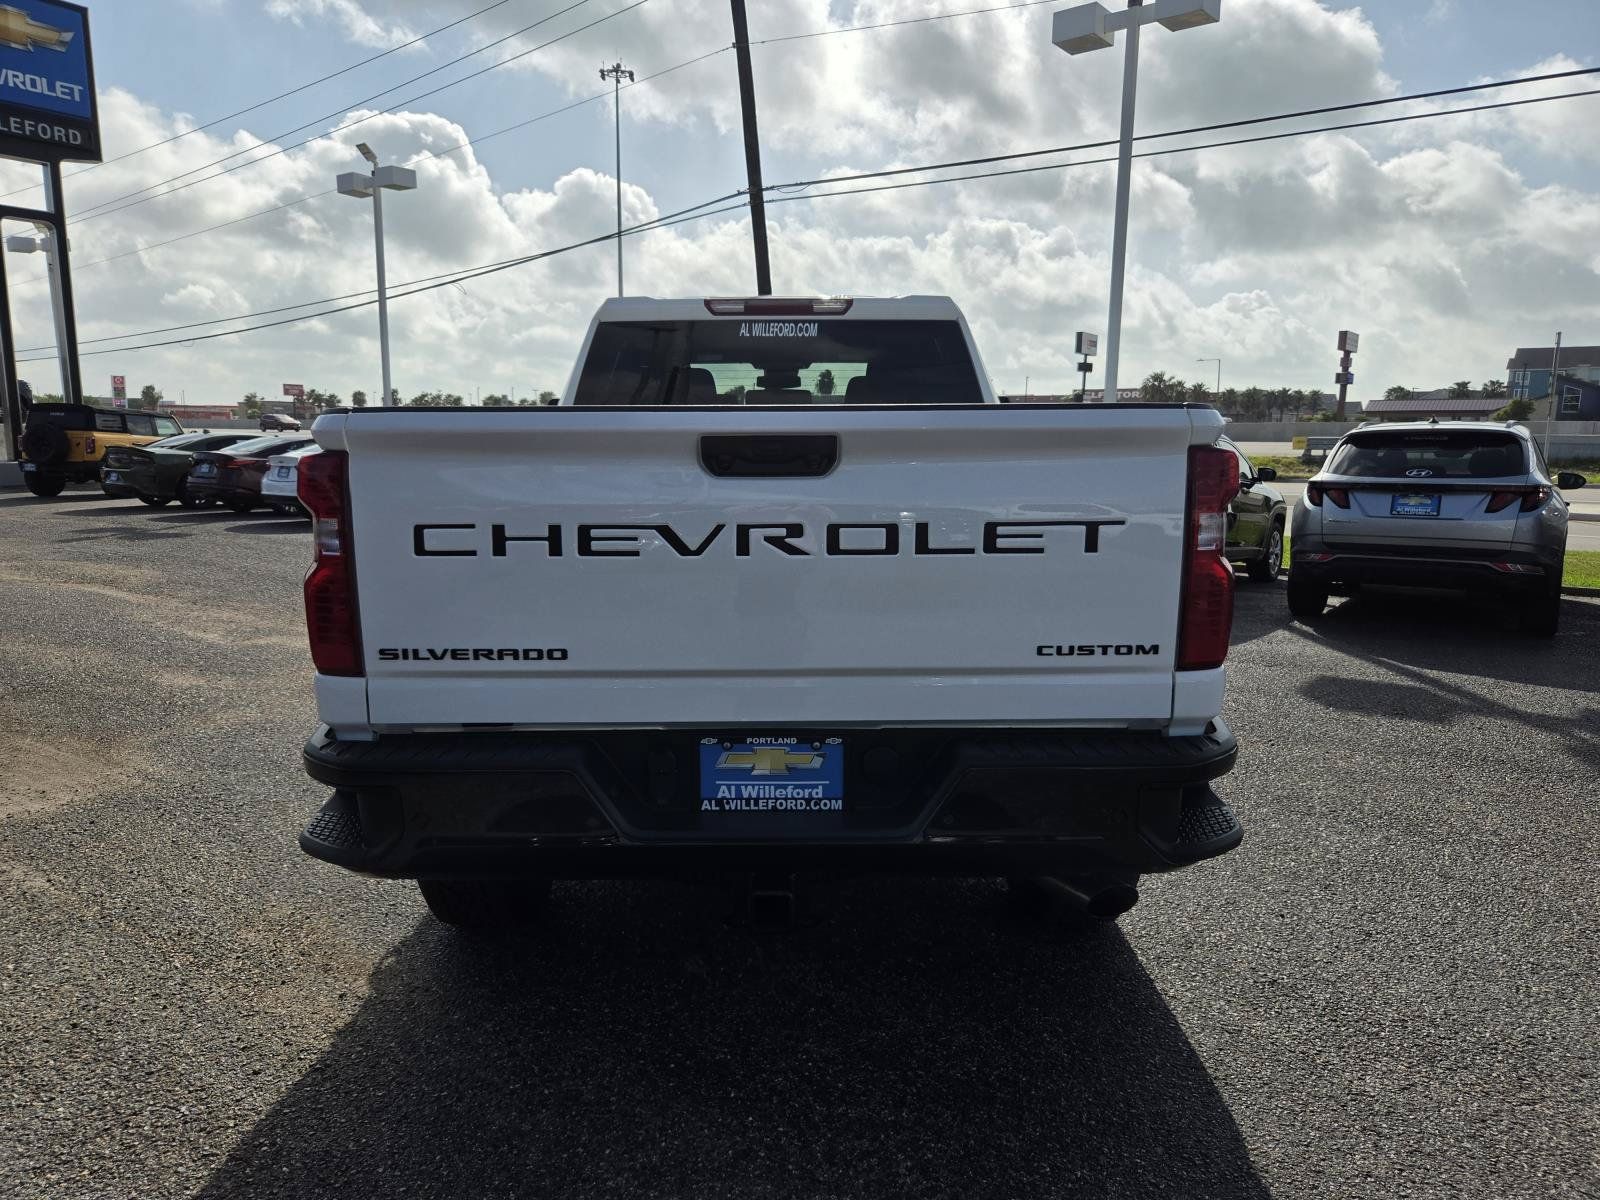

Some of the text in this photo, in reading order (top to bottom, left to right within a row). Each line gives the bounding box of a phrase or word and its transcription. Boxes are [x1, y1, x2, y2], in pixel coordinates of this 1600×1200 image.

[740, 322, 818, 337] AL WILLEFORD.COM
[414, 522, 1126, 557] CHEVROLET
[379, 648, 568, 661] SILVERADO
[1037, 645, 1160, 656] CUSTOM
[717, 785, 823, 798] Al Willeford
[701, 799, 843, 811] AL WILLEFORD.COM
